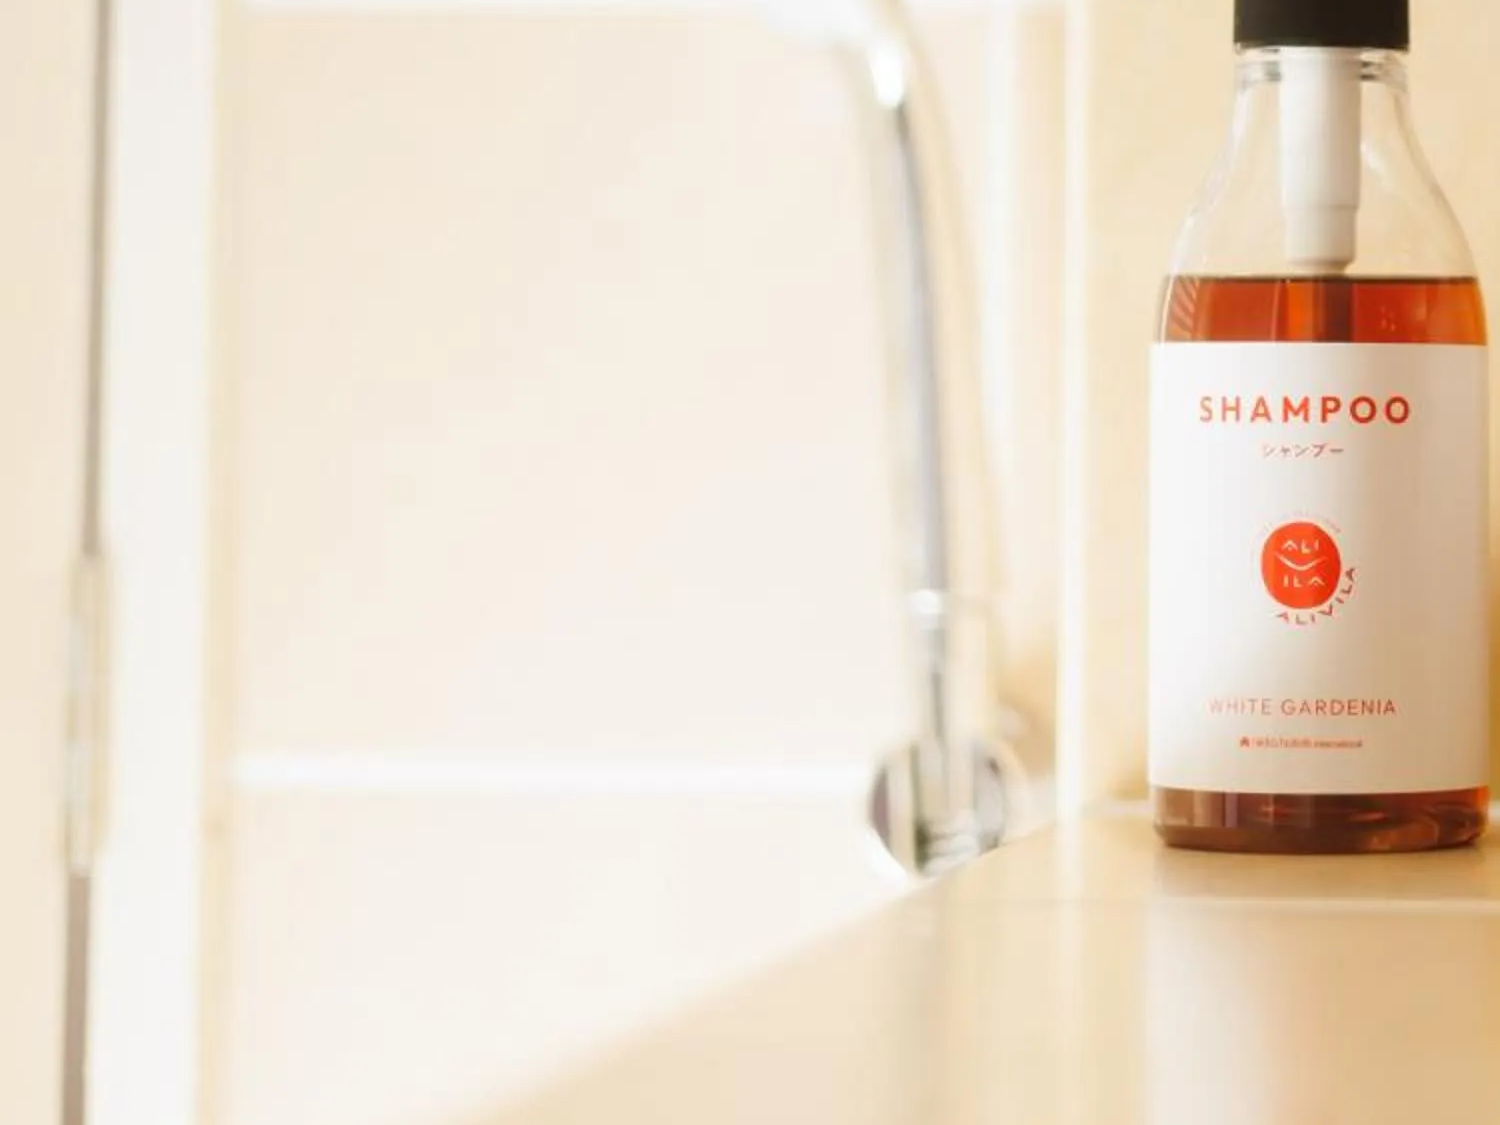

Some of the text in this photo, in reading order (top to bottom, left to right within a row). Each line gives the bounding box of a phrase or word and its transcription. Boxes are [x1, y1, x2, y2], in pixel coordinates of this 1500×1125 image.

[1199, 395, 1411, 424] SHAMPOO
[1262, 442, 1345, 459] シャンプー
[1275, 567, 1355, 625] ALIVILA
[1209, 698, 1397, 717] WHITE GARDENIA
